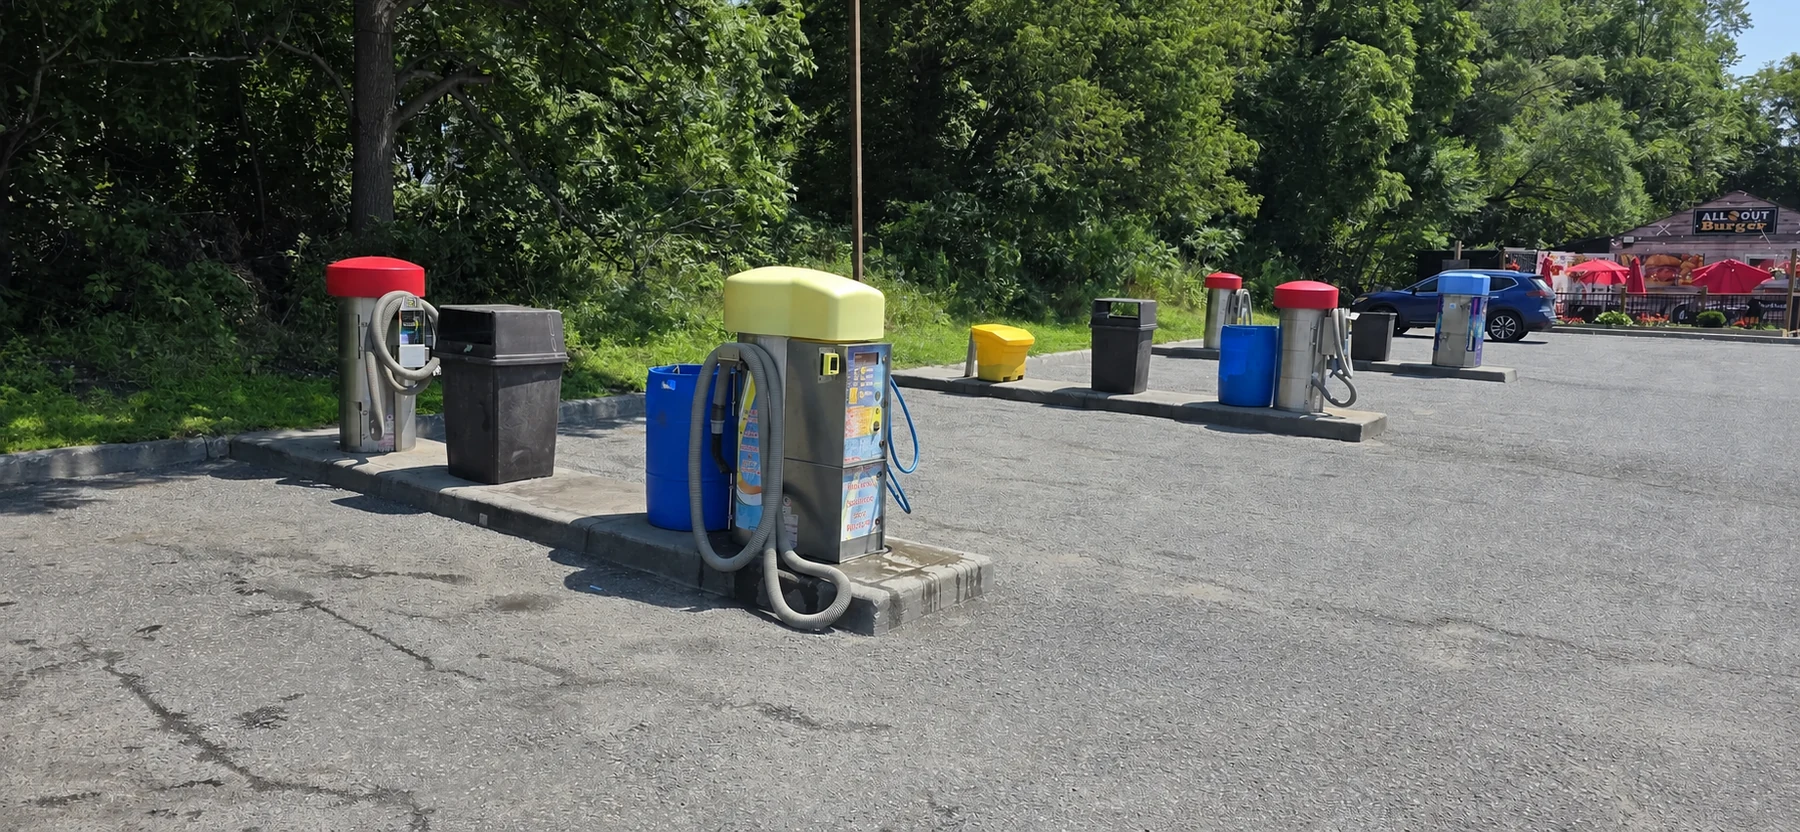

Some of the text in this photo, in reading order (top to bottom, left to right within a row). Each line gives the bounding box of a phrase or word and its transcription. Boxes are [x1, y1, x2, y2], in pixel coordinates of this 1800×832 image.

[1702, 211, 1770, 220] ALL OUT
[1701, 221, 1767, 233] Burger
